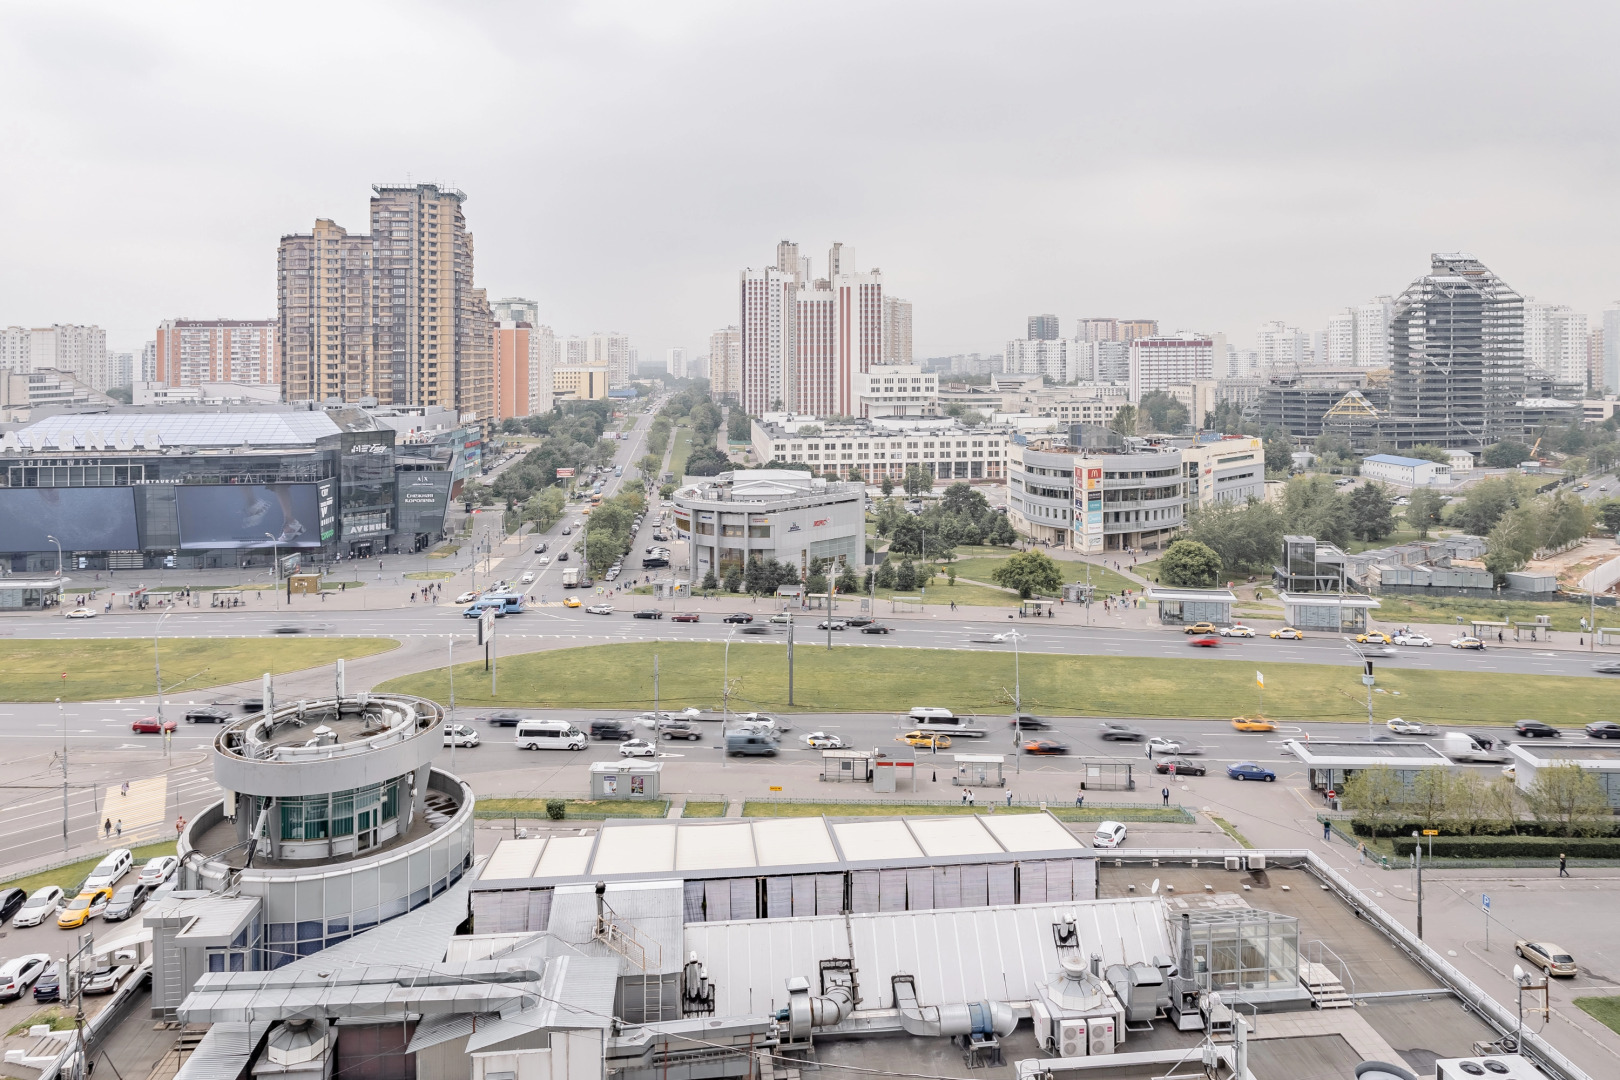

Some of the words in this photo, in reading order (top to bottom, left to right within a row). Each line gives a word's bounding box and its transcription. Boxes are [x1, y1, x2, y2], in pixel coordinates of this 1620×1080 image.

[0, 430, 161, 452] AVENUE
[18, 459, 102, 467] SOUTHWEST
[350, 522, 387, 534] AVENUE
